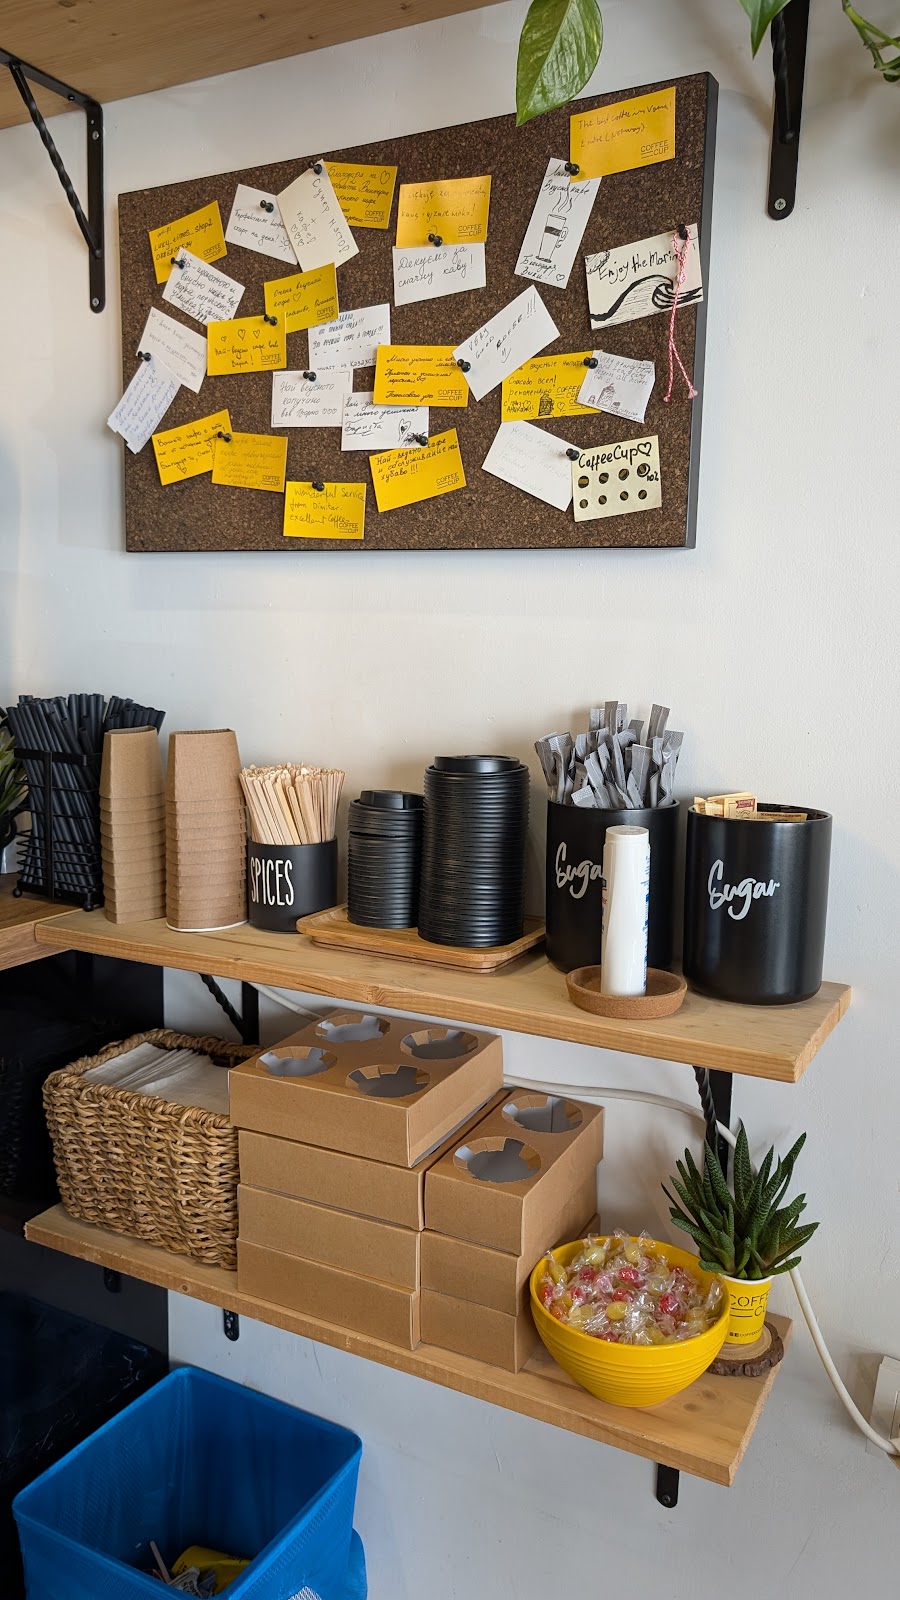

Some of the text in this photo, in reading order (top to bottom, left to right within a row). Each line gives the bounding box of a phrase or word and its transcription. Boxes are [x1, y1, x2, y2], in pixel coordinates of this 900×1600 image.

[578, 119, 594, 130] The
[640, 139, 669, 153] COFFEE
[653, 147, 669, 156] CUP
[458, 223, 482, 232] COFFEE
[203, 243, 221, 255] COFFEE
[598, 261, 629, 285] Enjoy
[631, 254, 648, 273] the
[316, 305, 334, 316] COFFEE
[261, 353, 281, 361] COFFEE
[578, 444, 639, 471] CoffeeCup
[262, 474, 280, 482] COFFEE
[436, 471, 460, 485] COFFEE
[447, 477, 460, 486] CUP
[294, 485, 365, 503] Wonderful Service
[289, 498, 307, 511] from
[555, 840, 605, 899] Suga
[249, 855, 294, 906] SPICES
[707, 858, 781, 921] Sugar
